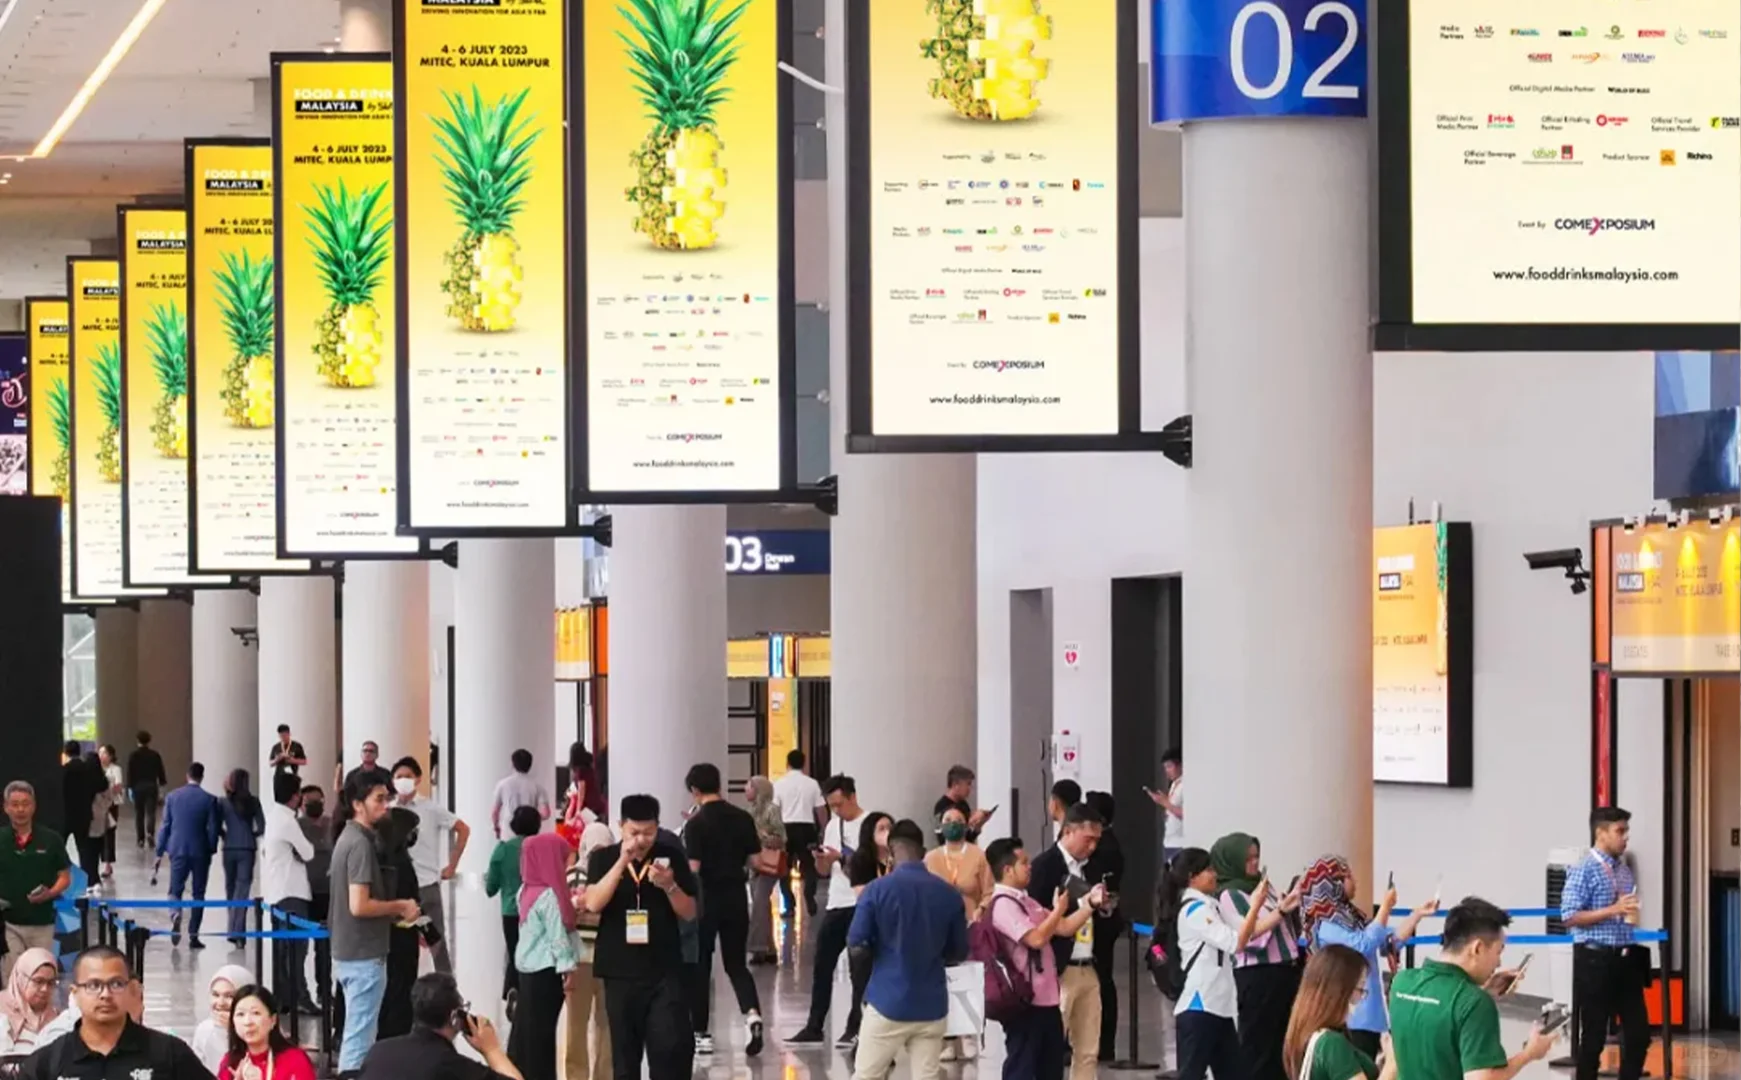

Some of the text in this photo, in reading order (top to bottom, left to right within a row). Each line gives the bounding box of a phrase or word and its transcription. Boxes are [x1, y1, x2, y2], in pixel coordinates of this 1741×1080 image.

[441, 45, 449, 54] 4
[458, 45, 467, 54] 6
[469, 45, 496, 54] JULY
[499, 45, 528, 55] 2023
[1230, 1, 1359, 99] 02
[420, 57, 550, 67] MITEC, KUALA LUMPUR
[301, 102, 358, 111] MALAYSIA
[312, 145, 319, 153] 4
[326, 145, 334, 154] 6
[336, 145, 359, 153] JULY
[361, 144, 387, 154] 2023
[327, 155, 362, 164] KUALA
[210, 181, 258, 189] MALAYSIA
[1554, 217, 1656, 236] COMEXPOSIUM
[1493, 266, 1680, 284] www.fooddrinksmalaysia.com
[929, 394, 1062, 406] www.fooddrinksmalaysia.com
[726, 536, 763, 574] 03
